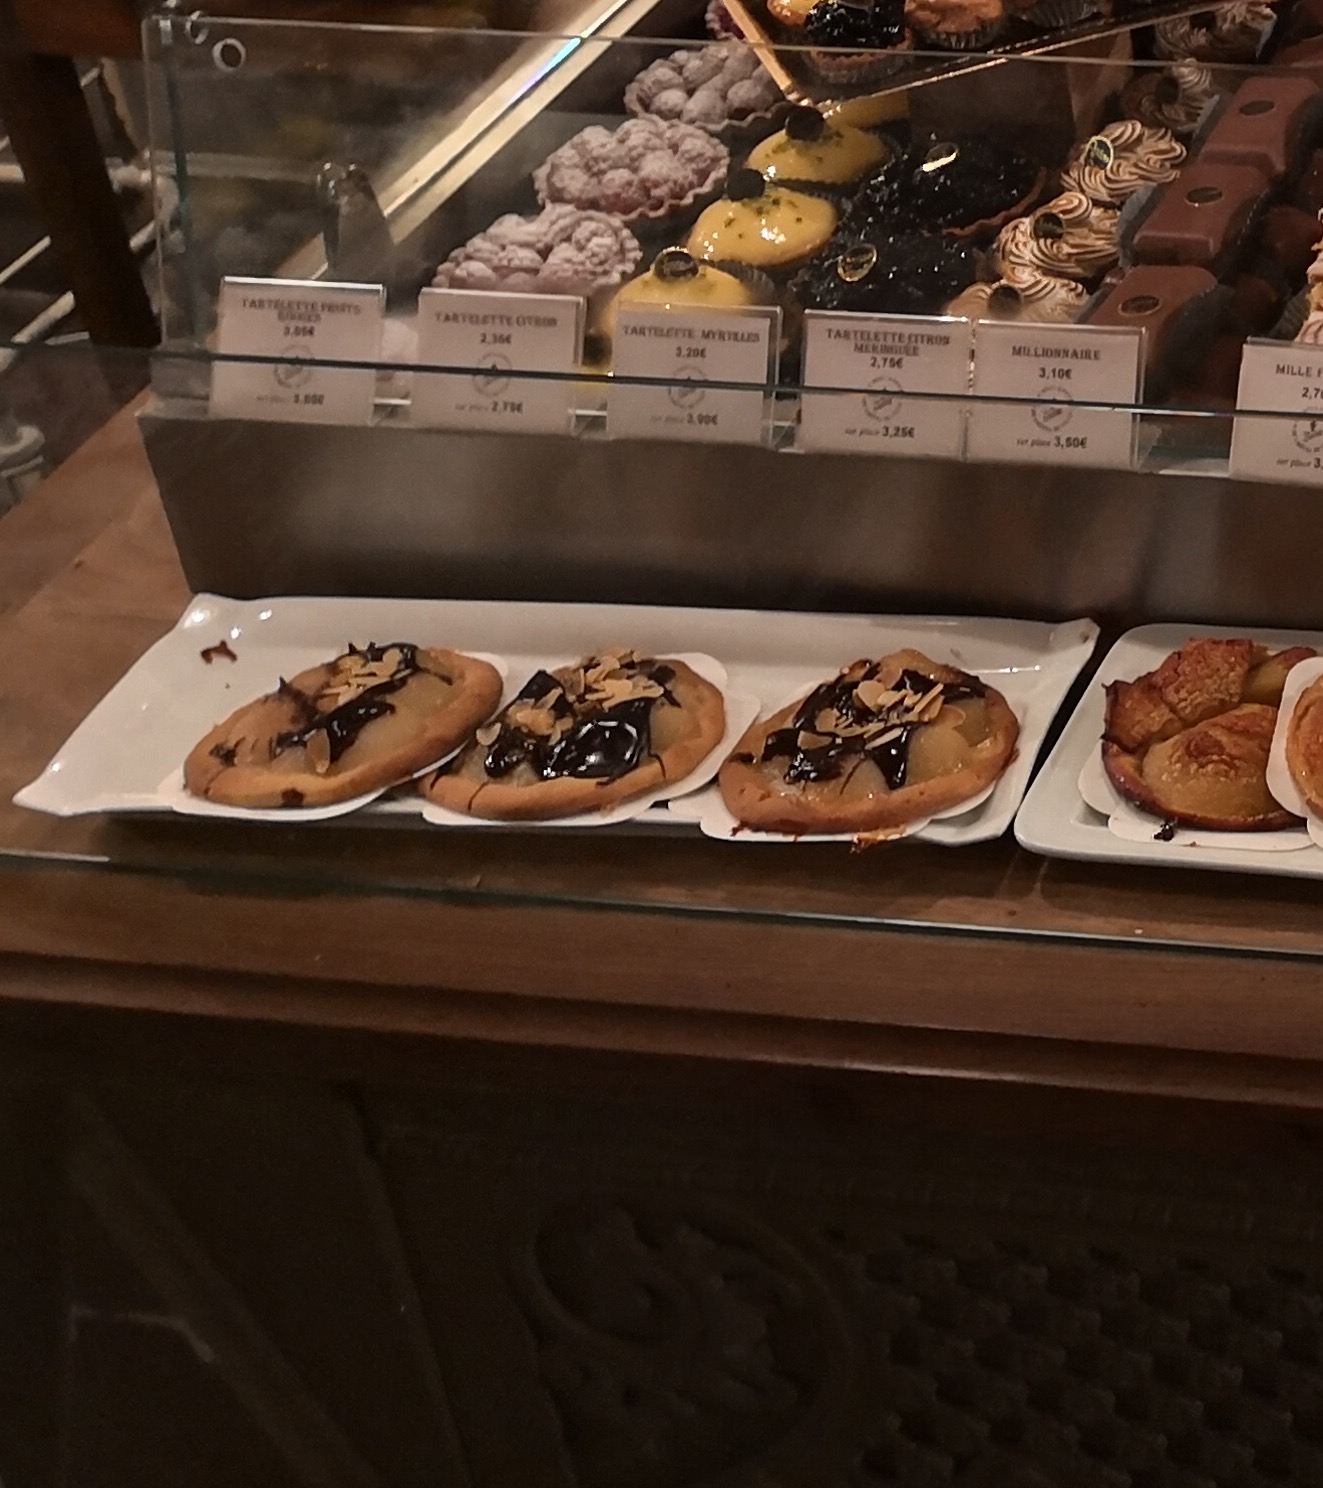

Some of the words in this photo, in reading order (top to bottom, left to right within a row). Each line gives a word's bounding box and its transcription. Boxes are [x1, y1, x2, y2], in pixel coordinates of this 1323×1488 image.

[435, 312, 513, 327] TARTELETTE
[623, 325, 695, 340] TARTELETTE
[701, 328, 760, 344] MYRTILLES
[826, 328, 907, 345] TARTELETTE
[1011, 345, 1101, 361] MILLIONNAIRE
[1038, 367, 1073, 380] 3,10€
[1275, 363, 1313, 378] MILLE
